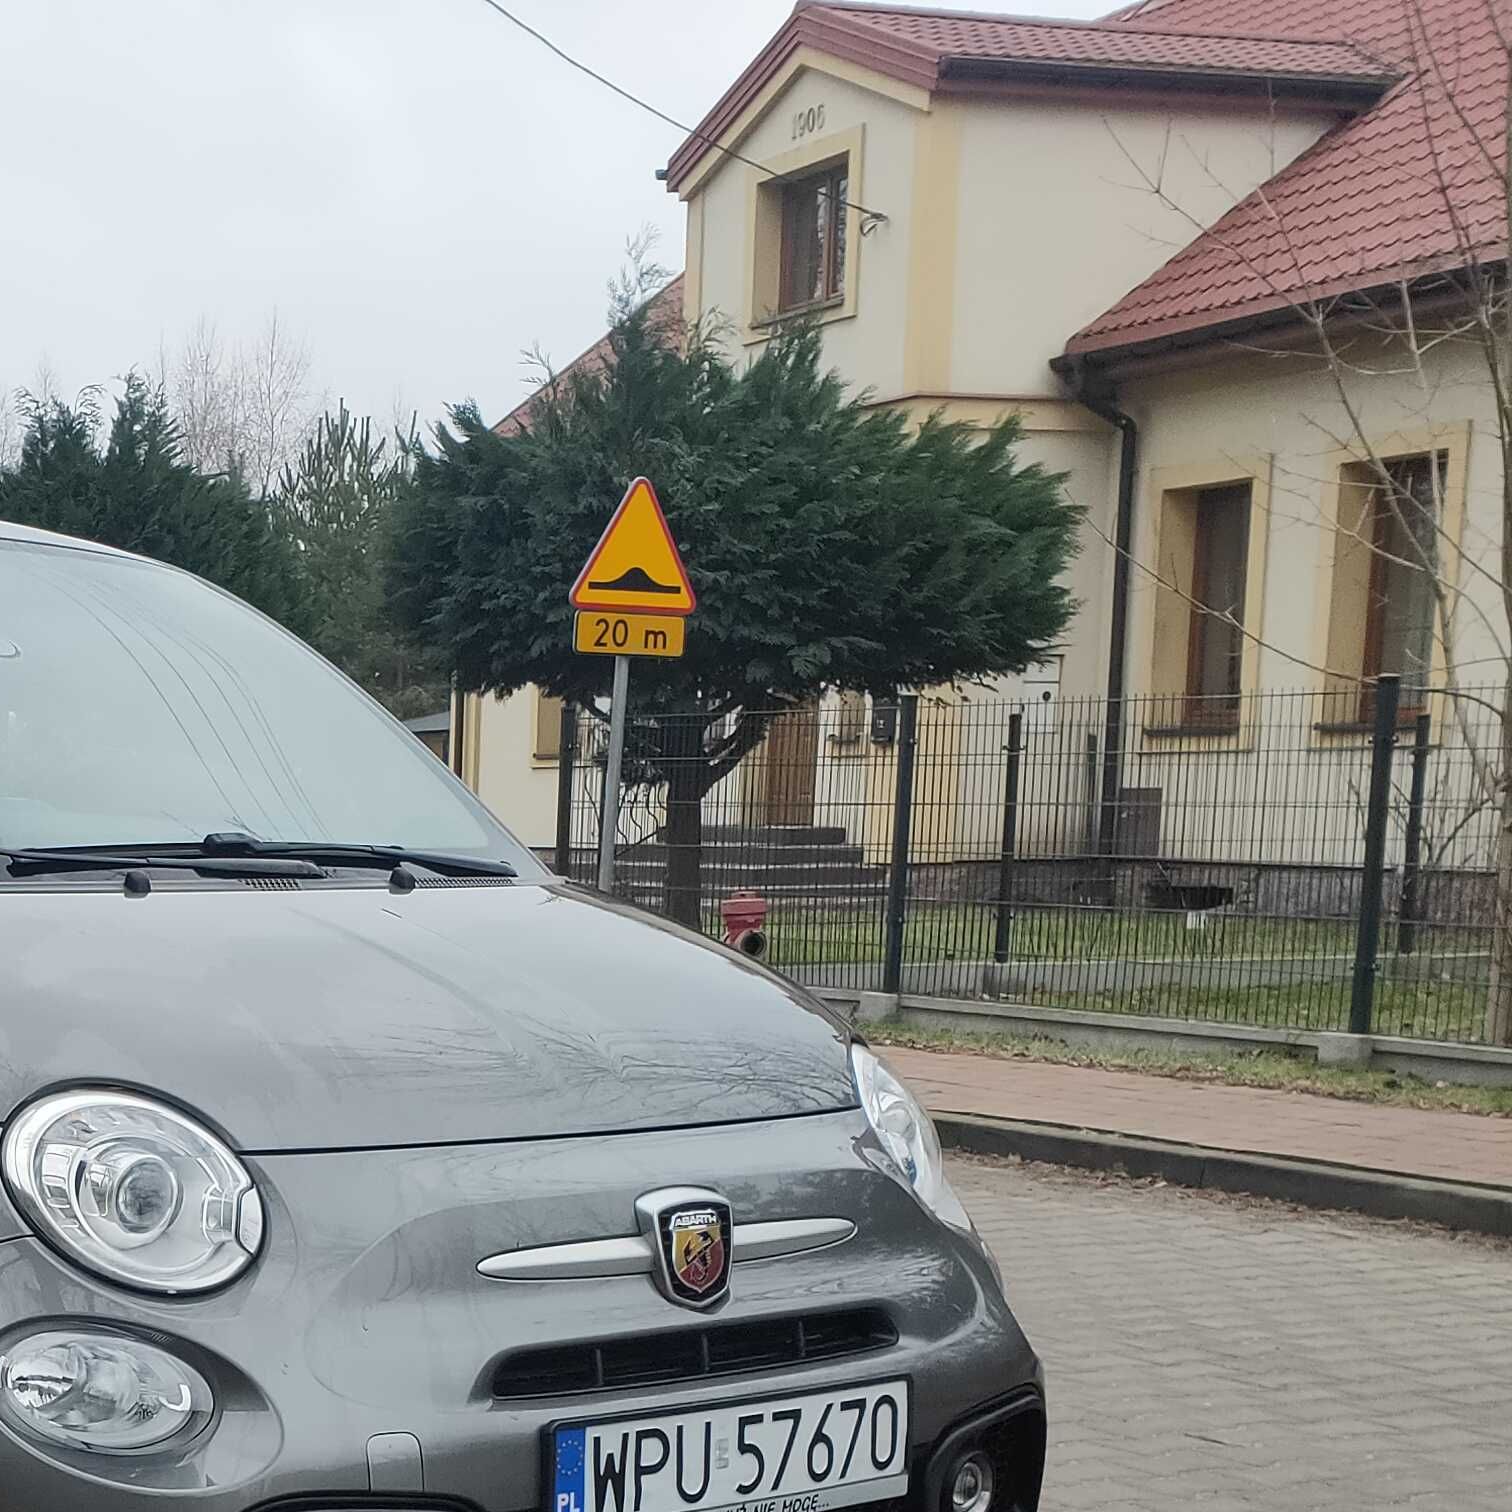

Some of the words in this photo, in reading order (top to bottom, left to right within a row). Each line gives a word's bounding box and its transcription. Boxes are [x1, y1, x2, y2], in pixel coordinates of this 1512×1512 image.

[594, 619, 628, 647] 20
[644, 630, 667, 649] m
[675, 1214, 716, 1226] ABARTH
[736, 1394, 899, 1496] 57670
